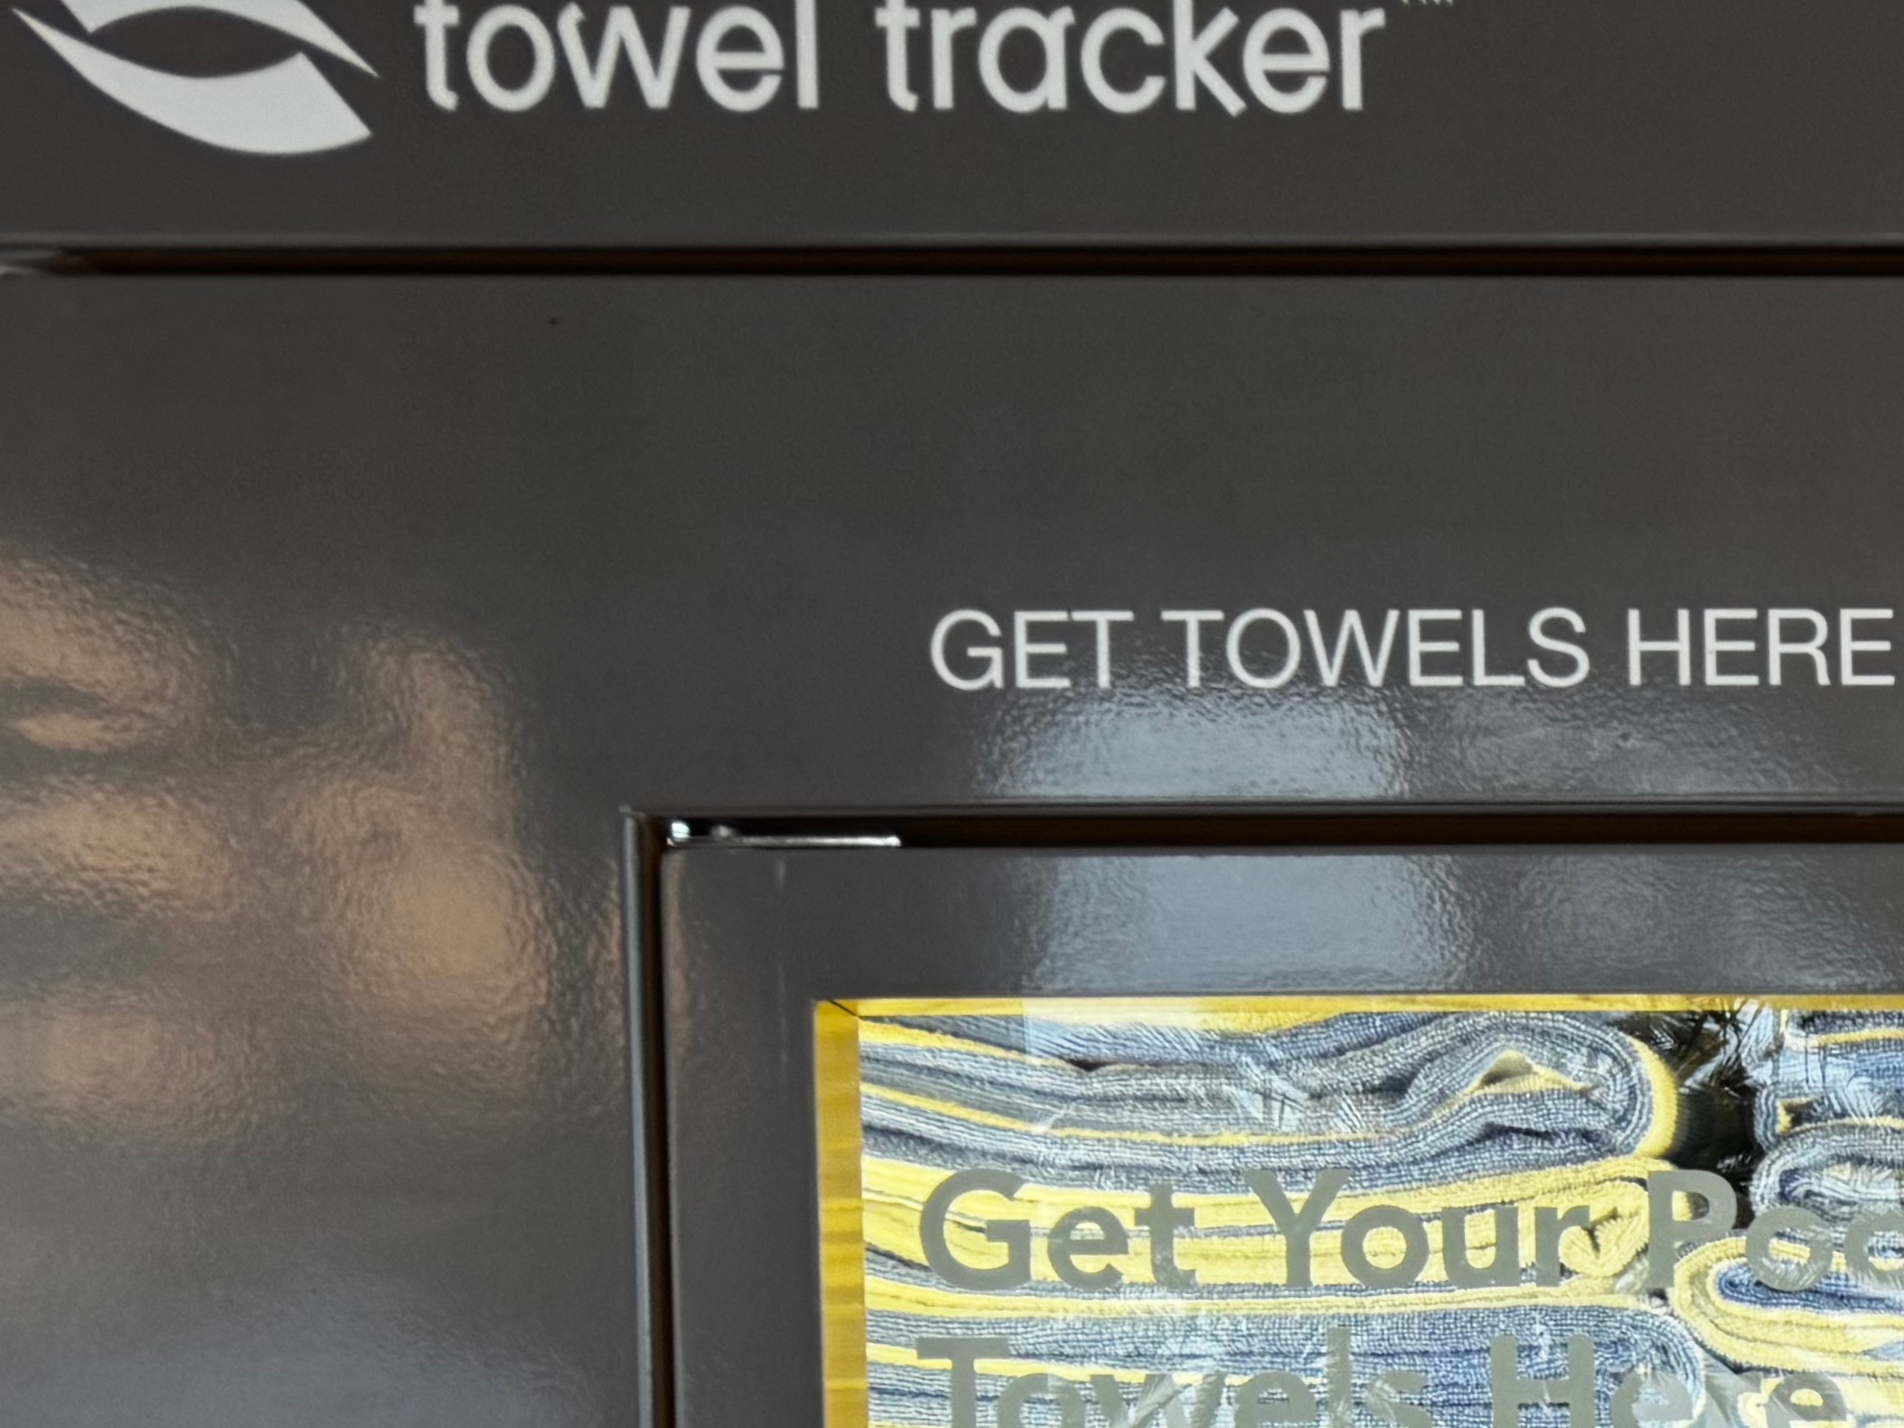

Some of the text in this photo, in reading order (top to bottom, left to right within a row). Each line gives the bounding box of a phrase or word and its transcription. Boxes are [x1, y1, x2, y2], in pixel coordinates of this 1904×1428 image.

[413, 0, 1386, 116] towel tracker
[929, 606, 1896, 691] GET TOWELS HERE
[919, 1166, 1199, 1291] Get
[1244, 1166, 1592, 1291] Your
